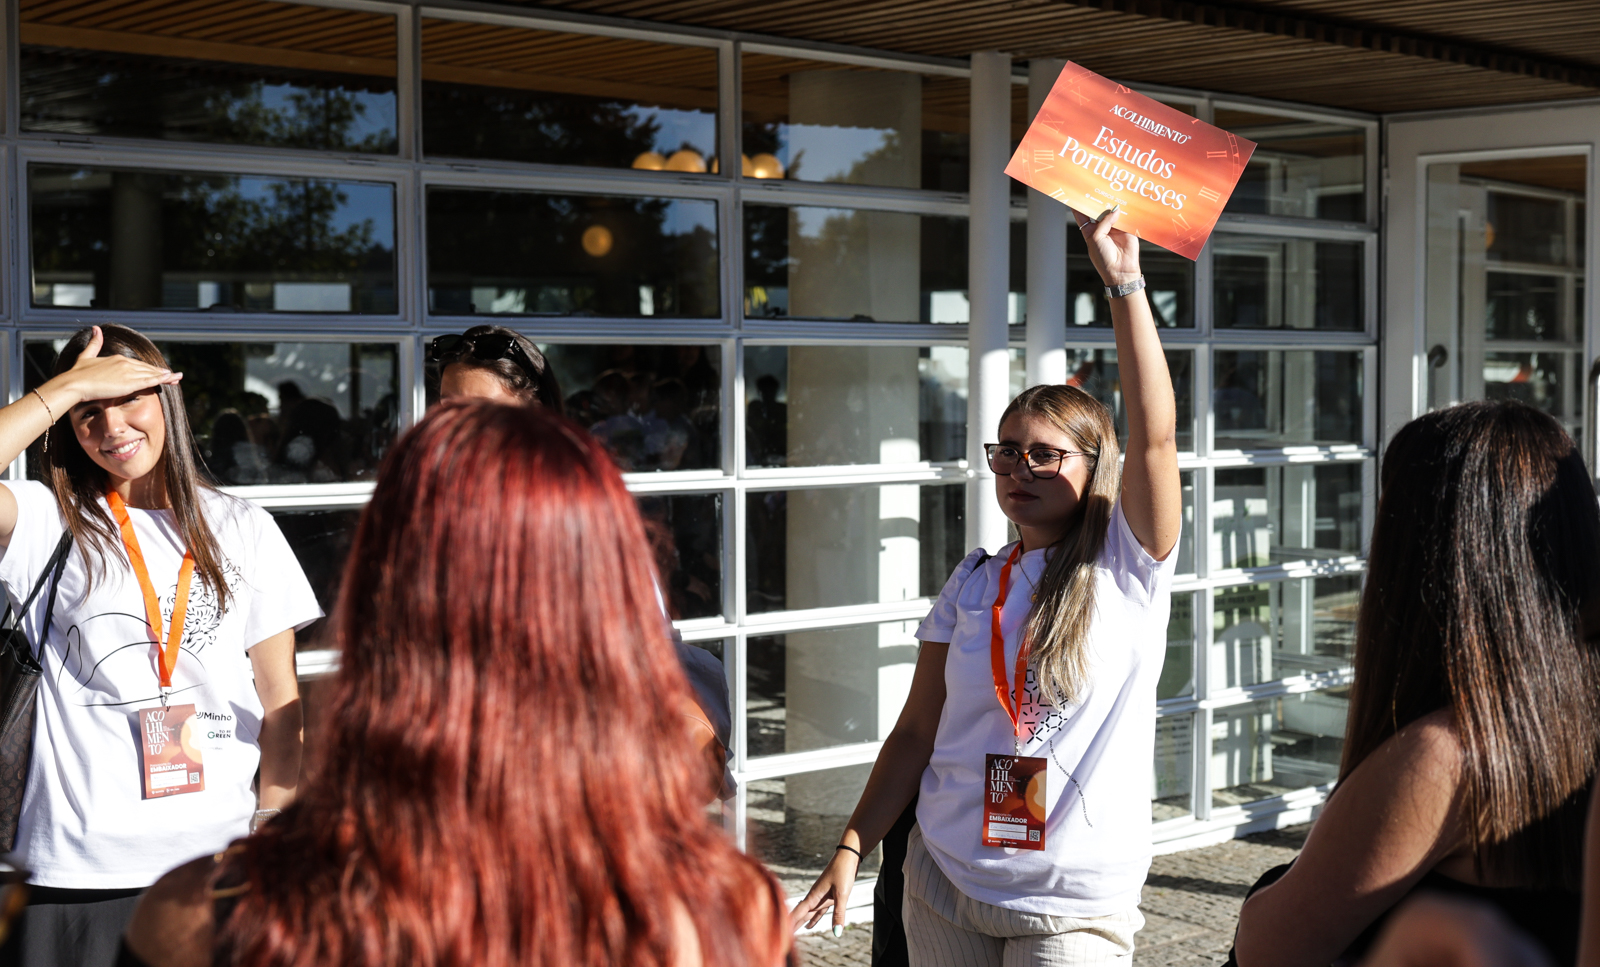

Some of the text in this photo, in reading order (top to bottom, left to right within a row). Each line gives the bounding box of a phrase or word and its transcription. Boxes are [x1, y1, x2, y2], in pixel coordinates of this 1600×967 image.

[1109, 104, 1188, 145] ACOLHIMENTO
[1092, 125, 1176, 179] Estudos
[1058, 136, 1187, 210] Portugueses
[145, 710, 165, 722] ACO
[146, 721, 164, 734] LHI
[147, 732, 170, 744] MEN
[207, 731, 231, 739] GREEN
[148, 744, 162, 756] TO
[150, 763, 187, 773] EMBAIXADOR
[991, 758, 1013, 770] ACO
[991, 769, 1009, 781] LHI
[990, 780, 1014, 793] MEN
[990, 792, 1004, 804] TO
[989, 815, 1028, 824] EMBAIXADOR
